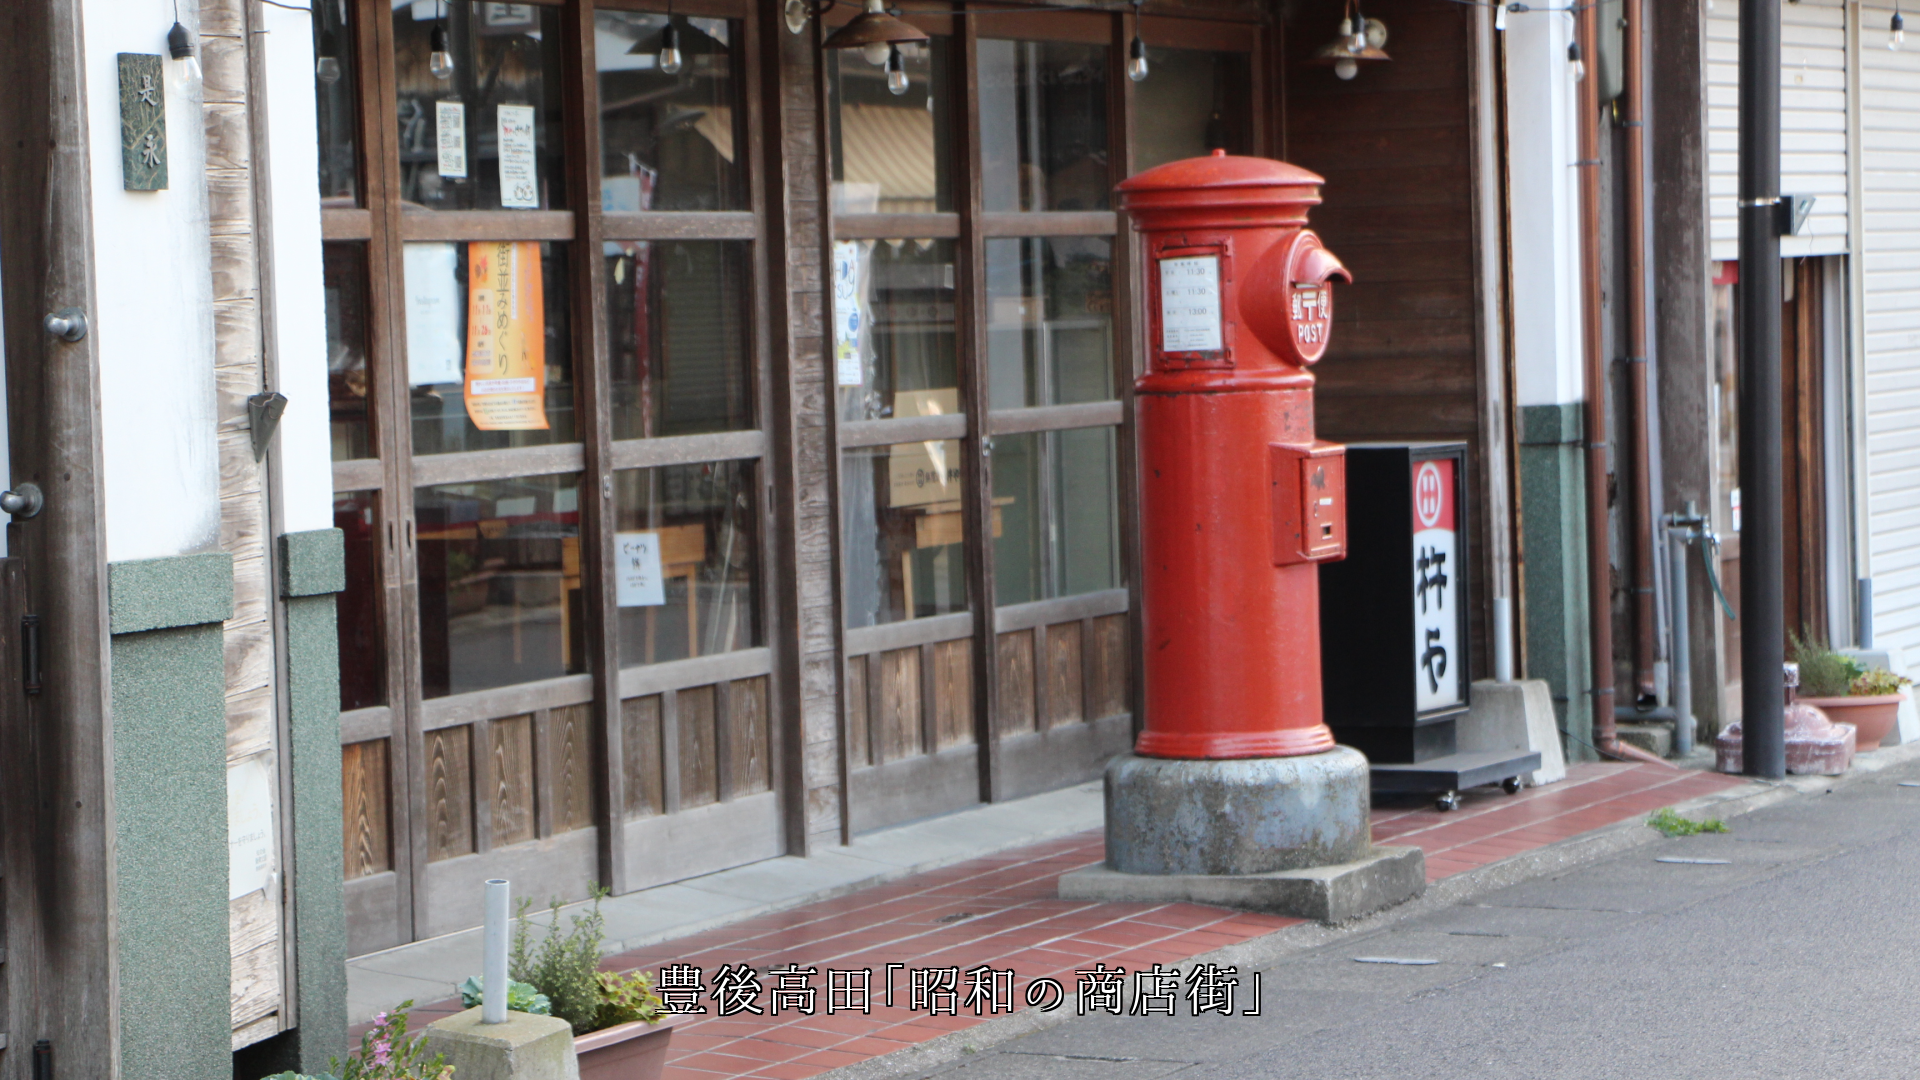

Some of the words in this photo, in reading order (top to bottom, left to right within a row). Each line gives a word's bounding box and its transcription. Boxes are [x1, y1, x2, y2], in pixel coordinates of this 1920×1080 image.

[137, 74, 161, 168] 是永
[496, 242, 510, 376] 街並みめぐり
[1297, 323, 1323, 343] POST
[1416, 545, 1448, 695] 杵や
